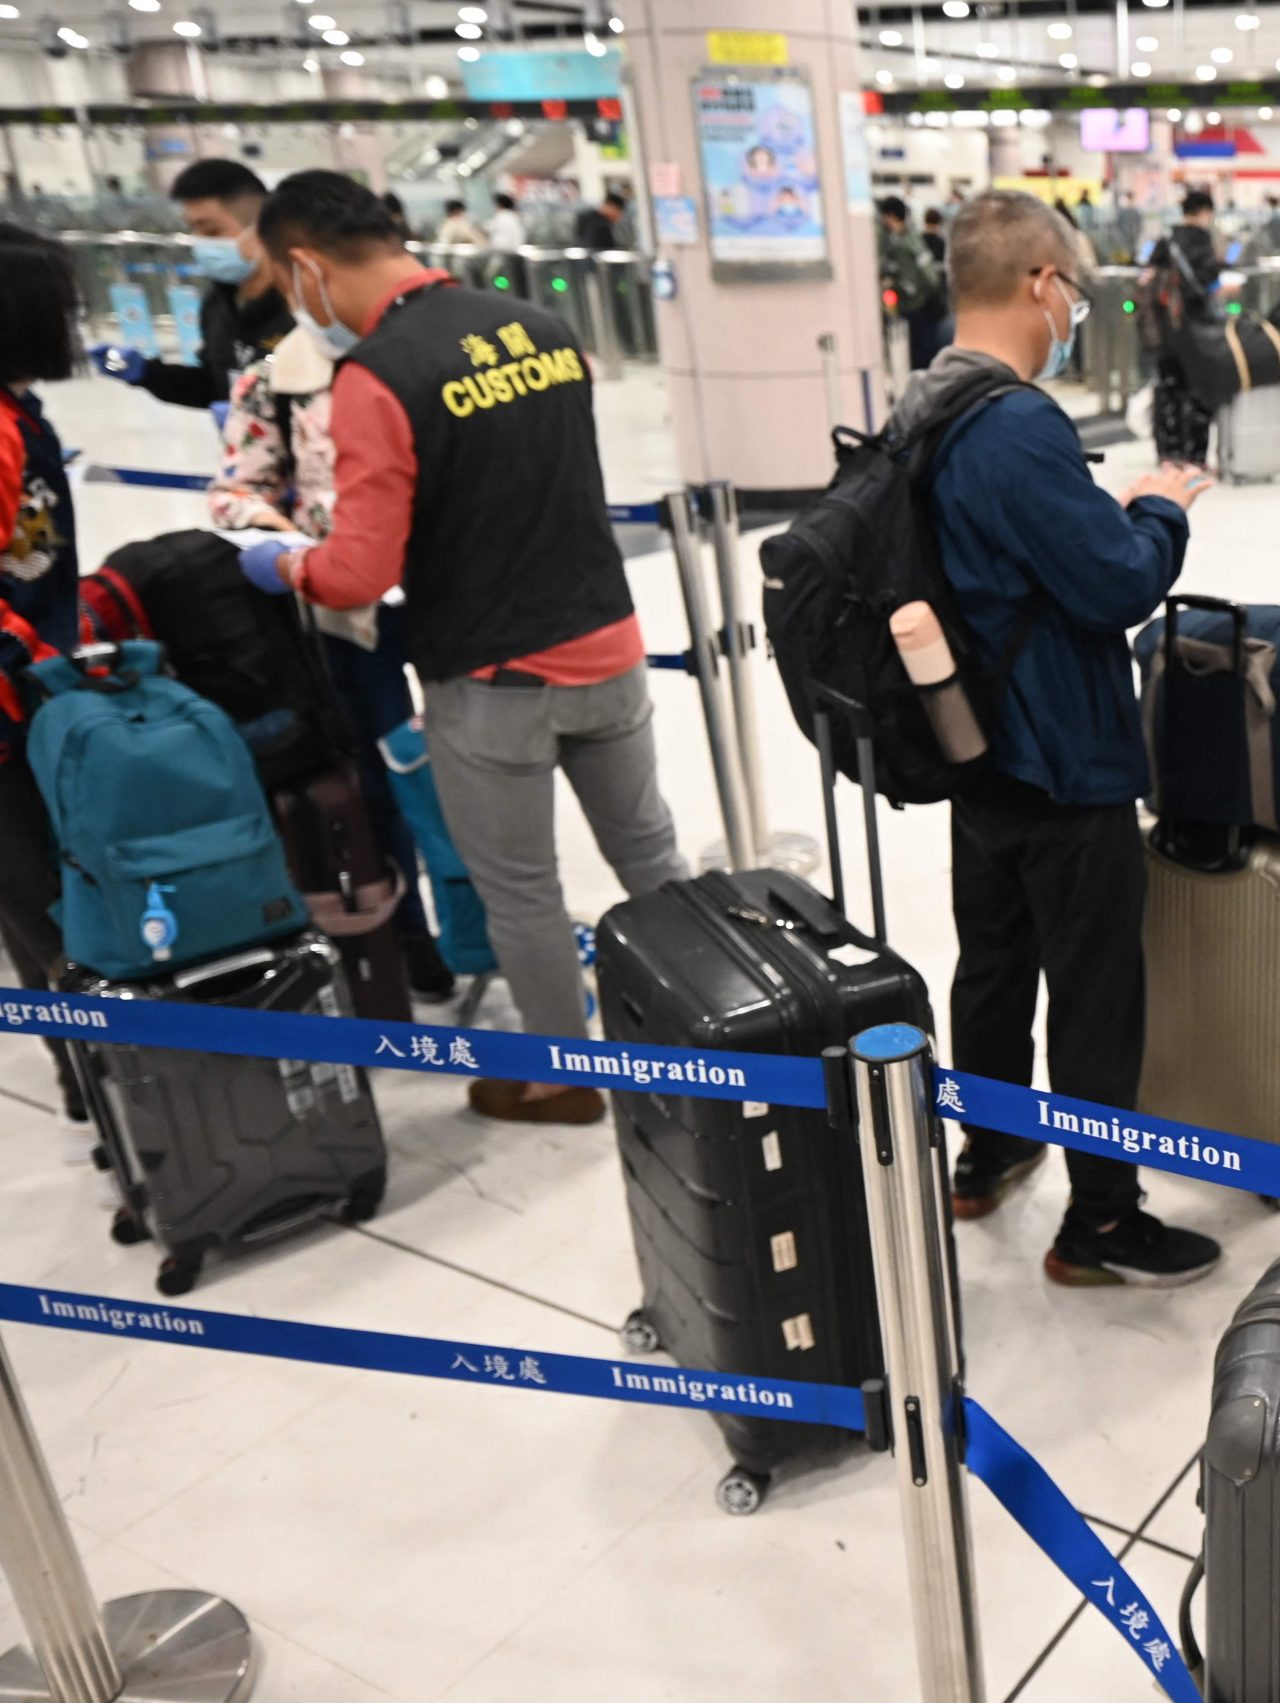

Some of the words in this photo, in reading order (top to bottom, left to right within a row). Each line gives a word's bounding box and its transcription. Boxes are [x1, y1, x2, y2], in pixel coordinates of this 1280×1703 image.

[442, 347, 583, 417] CUSTOMS
[0, 1002, 108, 1028] gration
[373, 1034, 481, 1069] 入境處
[549, 1046, 747, 1088] Immigration
[936, 1077, 967, 1113] 處
[1036, 1100, 1243, 1171] Immigration
[38, 1294, 204, 1336] Immigration
[450, 1352, 548, 1384] 入境處
[612, 1366, 795, 1409] Immigration
[1091, 1575, 1173, 1673] 入境處
